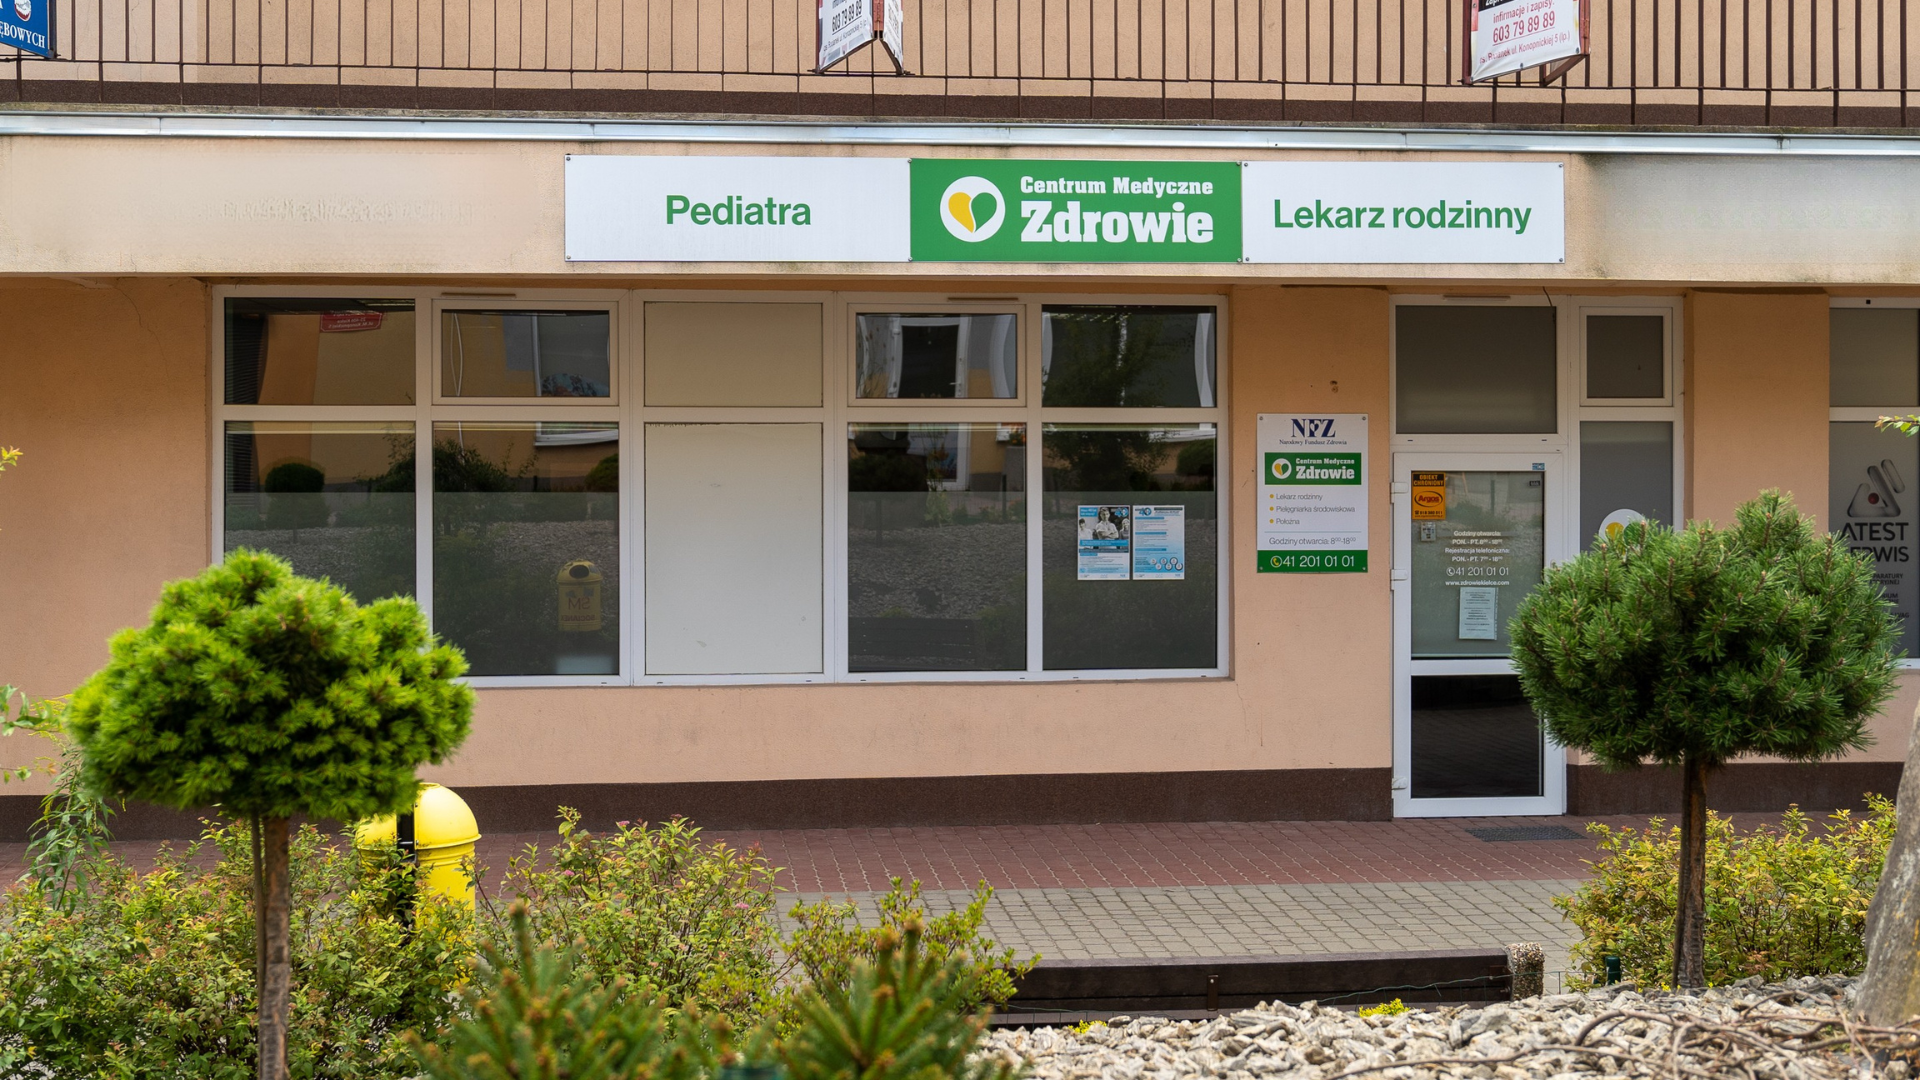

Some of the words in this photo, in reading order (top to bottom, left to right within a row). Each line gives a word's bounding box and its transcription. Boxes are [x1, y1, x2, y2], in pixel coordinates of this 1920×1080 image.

[832, 13, 841, 32] 603
[841, 8, 848, 26] 79
[1493, 24, 1510, 43] 603
[1513, 19, 1525, 37] 79
[1527, 15, 1540, 33] 89
[1542, 10, 1555, 28] 89
[1519, 34, 1554, 53] Konopnickiej
[1021, 176, 1107, 194] Centrum
[1113, 177, 1214, 199] Medyczne
[667, 195, 811, 226] Pediatra
[1275, 199, 1385, 228] Lekarz
[1393, 200, 1532, 235] rodzinny
[1021, 201, 1214, 243] Zdrowie
[1291, 418, 1336, 438] NFZ
[1323, 458, 1355, 466] Medyczne
[1296, 466, 1355, 480] Zdrowie
[1297, 493, 1323, 501] rodzinny
[1418, 495, 1440, 503] Argos
[1276, 505, 1312, 514] Pielęgniarka
[1276, 517, 1300, 525] Położna
[1839, 522, 1909, 541] ATEST
[1269, 537, 1300, 546] Godziny
[1299, 537, 1329, 545] otwarcia:
[1283, 555, 1295, 567] 41
[1299, 555, 1320, 567] 201
[1324, 555, 1338, 567] 01
[1342, 555, 1355, 567] 01
[1456, 567, 1464, 576] 41
[1467, 567, 1483, 576] 201
[1486, 567, 1496, 576] 01
[1499, 567, 1509, 576] 01
